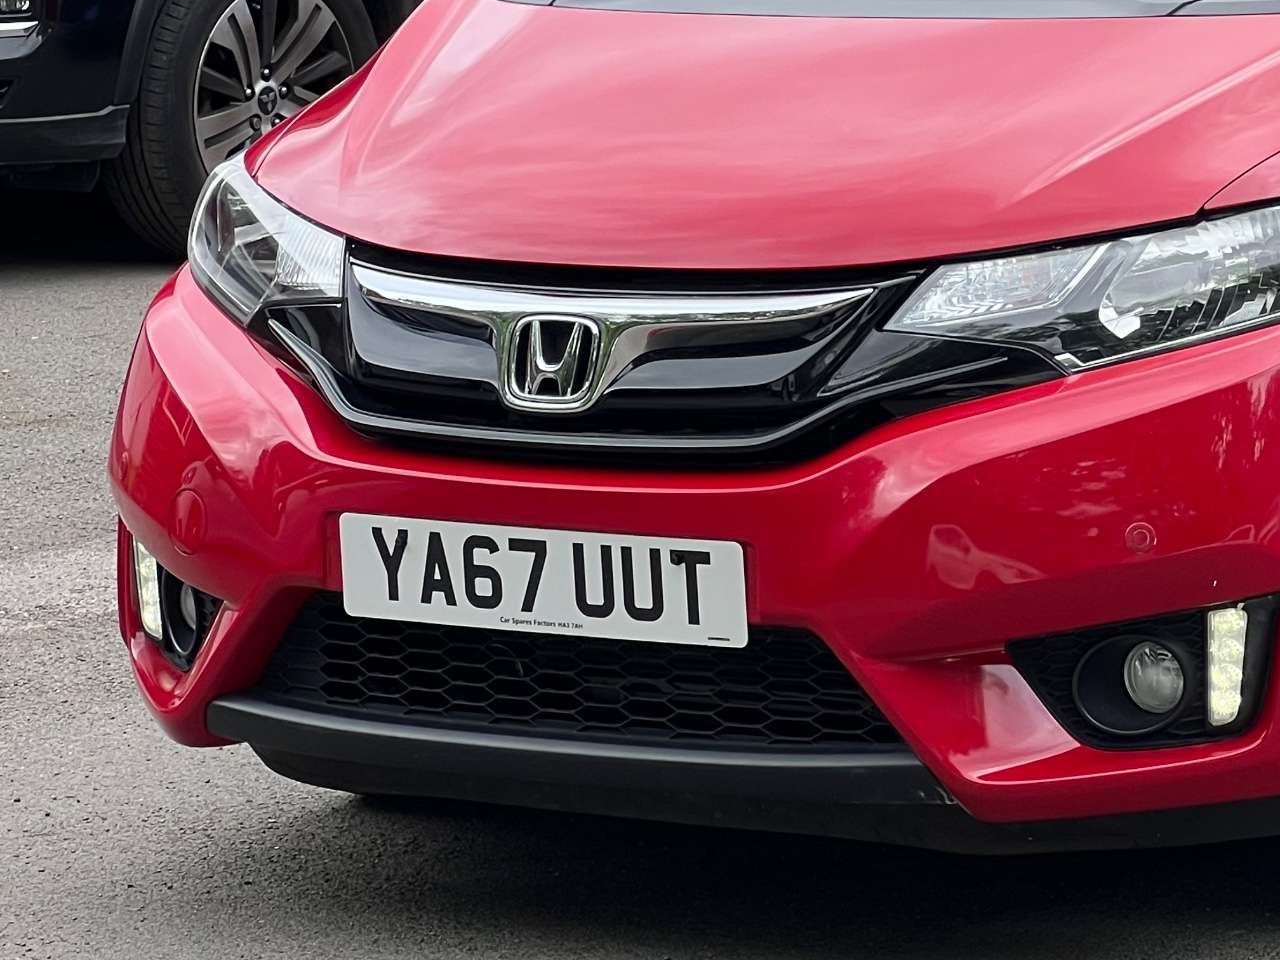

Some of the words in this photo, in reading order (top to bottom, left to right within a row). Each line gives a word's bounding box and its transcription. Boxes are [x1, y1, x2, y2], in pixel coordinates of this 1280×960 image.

[371, 526, 548, 613] YA67
[571, 542, 712, 626] UUT
[500, 616, 510, 624] Car
[512, 618, 532, 626] Spares
[534, 619, 556, 628] Factors
[557, 621, 570, 629] HA3
